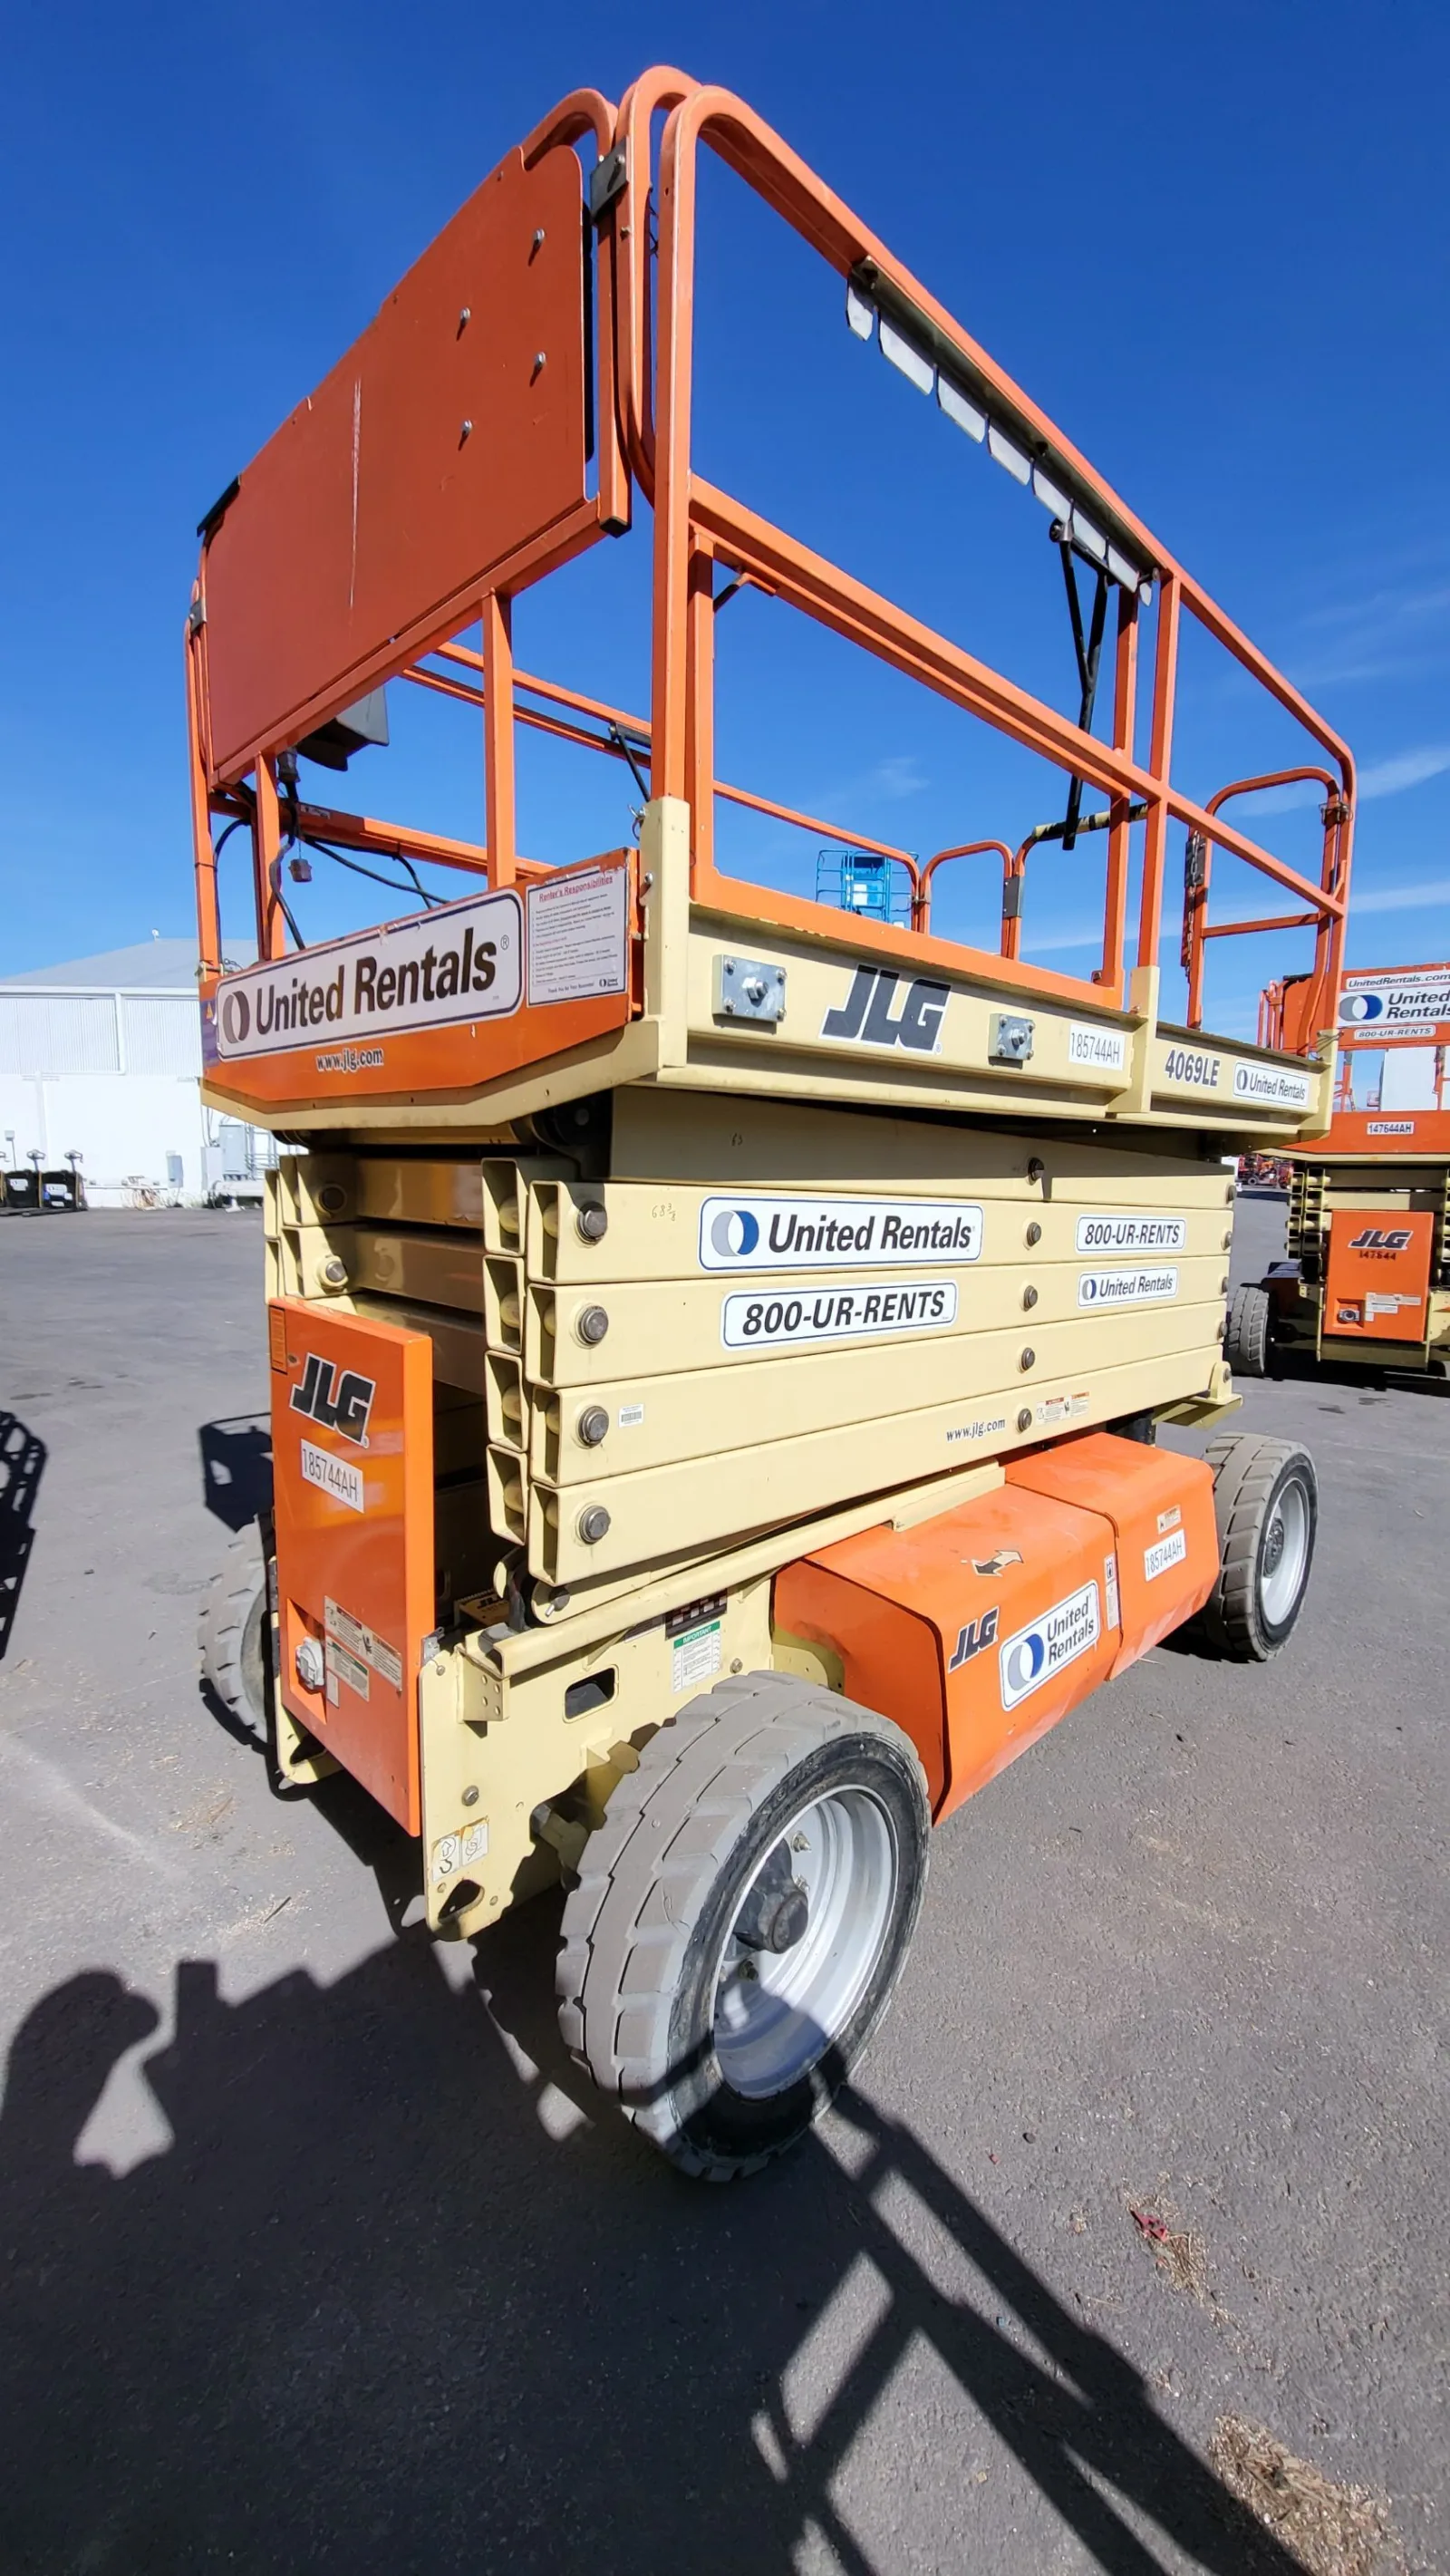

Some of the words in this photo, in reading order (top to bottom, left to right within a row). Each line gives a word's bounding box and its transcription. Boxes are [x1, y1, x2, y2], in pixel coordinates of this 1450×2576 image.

[255, 964, 344, 1035] United
[354, 927, 497, 1015] Rentals
[1348, 973, 1450, 988] UnitedRentals.com
[1387, 989, 1450, 1005] United
[821, 964, 952, 1052] JLG
[1070, 1031, 1120, 1065] 185744AH
[1358, 1027, 1432, 1038] 800-UR-RENTS
[316, 1048, 383, 1072] www.jlg.com
[1165, 1048, 1221, 1088] 4069LE
[1250, 1072, 1277, 1096] United
[1278, 1078, 1306, 1101] Rentals
[1368, 1123, 1412, 1134] 147644AH
[768, 1214, 875, 1254] United
[880, 1215, 972, 1250] Rentals
[1085, 1224, 1181, 1245] 800-UR-RENTS
[1350, 1230, 1412, 1249] JLG
[1099, 1276, 1136, 1298] United
[1137, 1273, 1174, 1293] Rentals
[742, 1290, 945, 1336] 800-UR-RENTS
[292, 1354, 374, 1443] JLG
[946, 1419, 1006, 1442] www.jlg.com
[302, 1448, 359, 1503] 185744AH
[1146, 1537, 1183, 1577] 185744AH
[682, 1625, 712, 1644] IMPORTANT
[1048, 1594, 1088, 1642] United
[950, 1607, 999, 1671] JLG
[1049, 1619, 1095, 1666] Rentals
